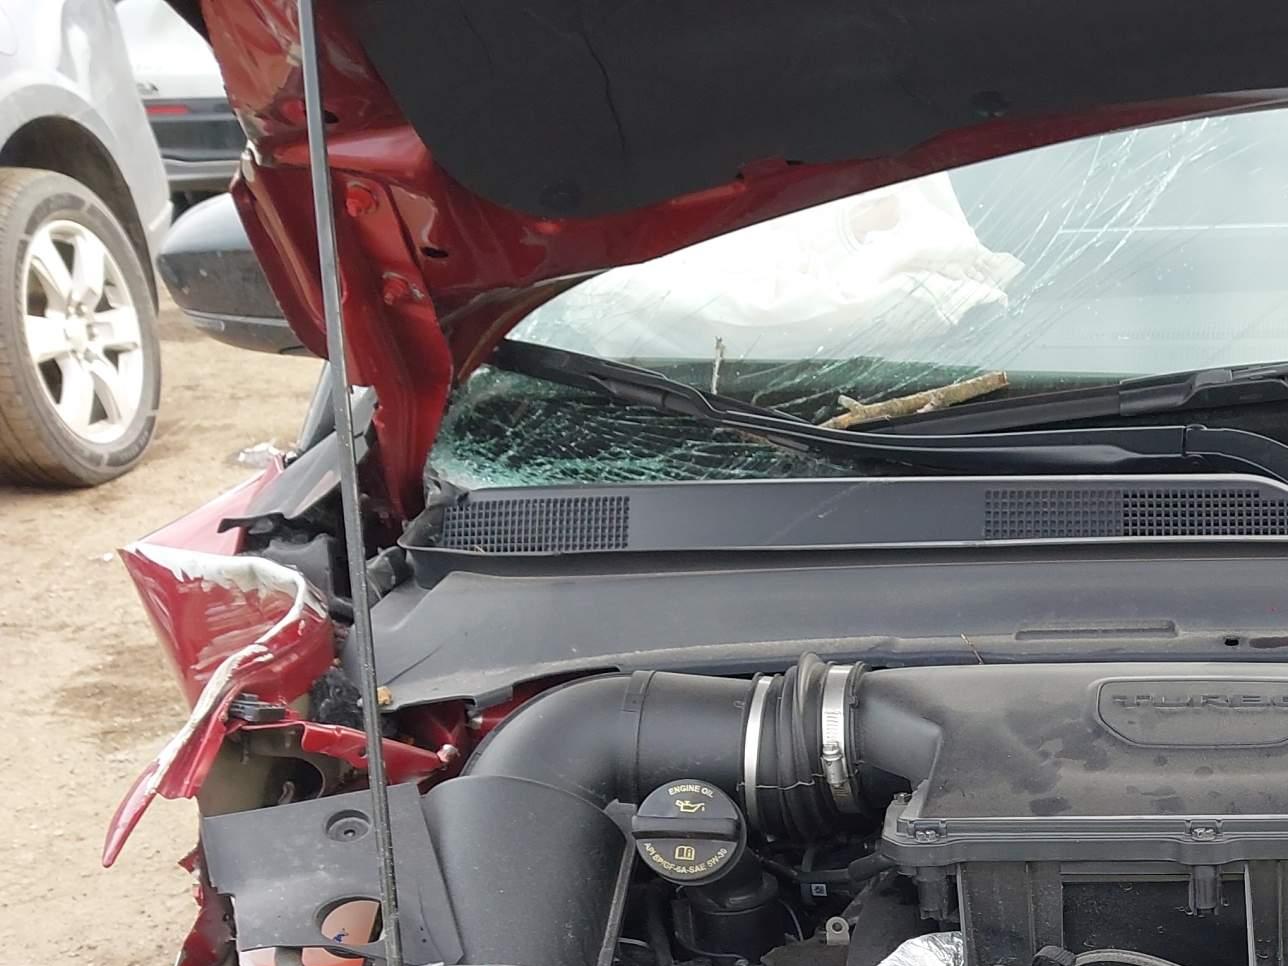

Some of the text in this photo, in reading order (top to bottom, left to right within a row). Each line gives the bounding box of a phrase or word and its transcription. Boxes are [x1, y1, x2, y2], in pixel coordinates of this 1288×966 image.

[668, 785, 714, 798] ENGINE OIL
[644, 843, 655, 856] API
[707, 848, 728, 867] 5W-30
